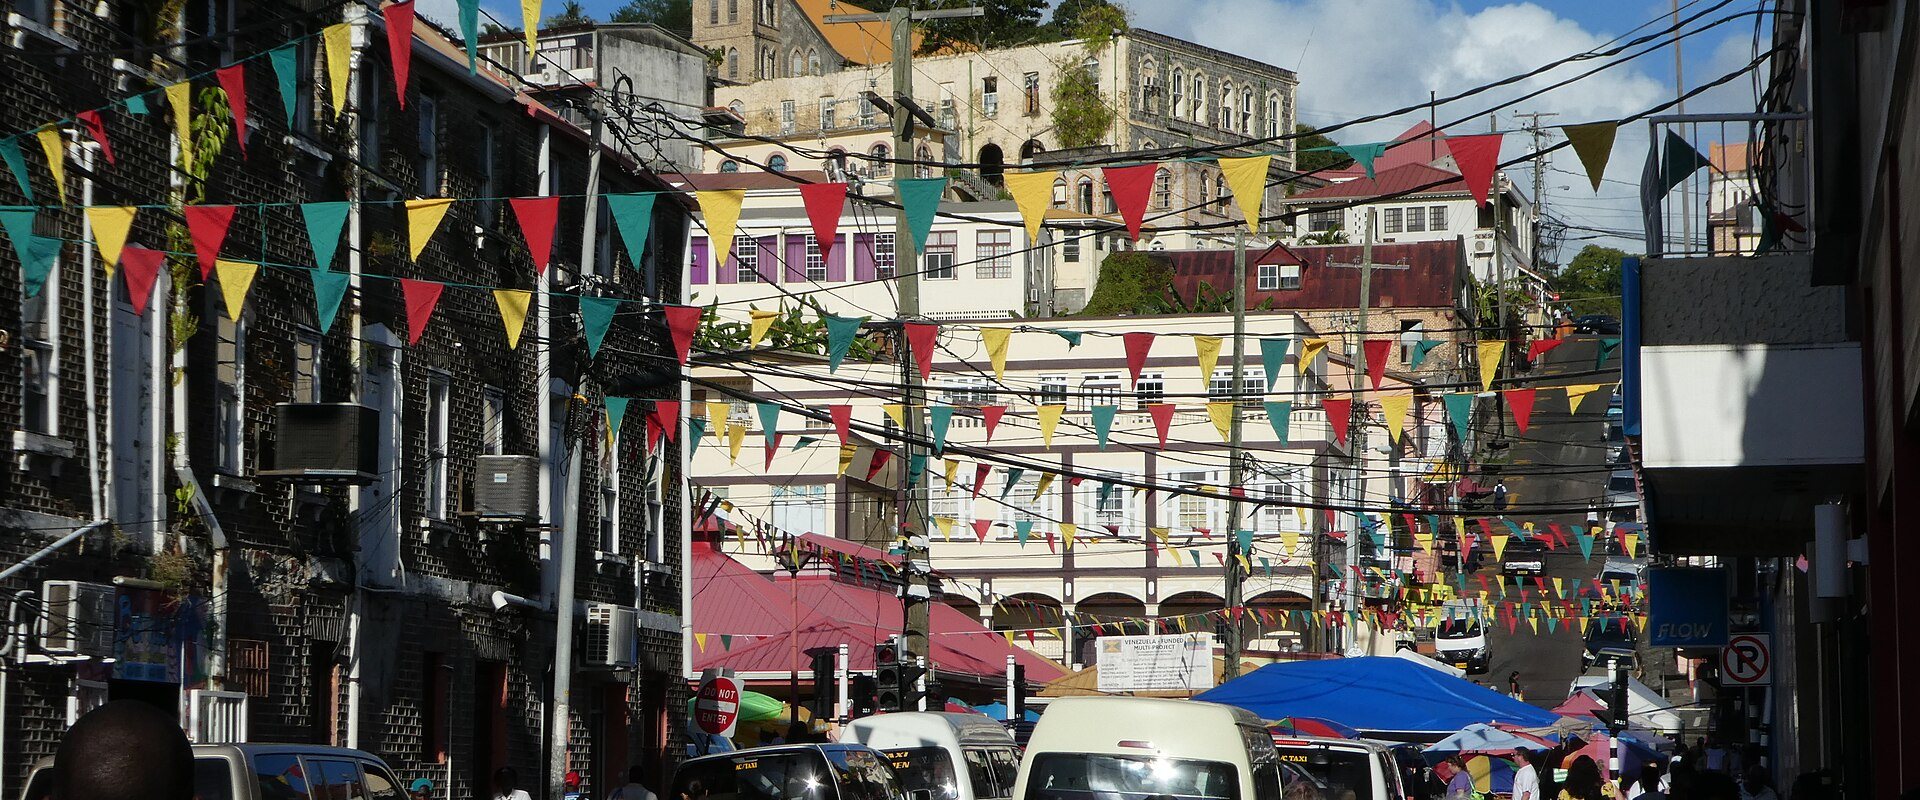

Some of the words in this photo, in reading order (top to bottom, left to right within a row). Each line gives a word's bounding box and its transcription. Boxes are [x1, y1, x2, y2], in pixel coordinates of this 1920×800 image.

[1657, 622, 1712, 638] FLOW
[704, 687, 716, 697] DO
[718, 689, 736, 700] NOT
[702, 712, 727, 725] ENTER
[887, 751, 909, 759] AXI
